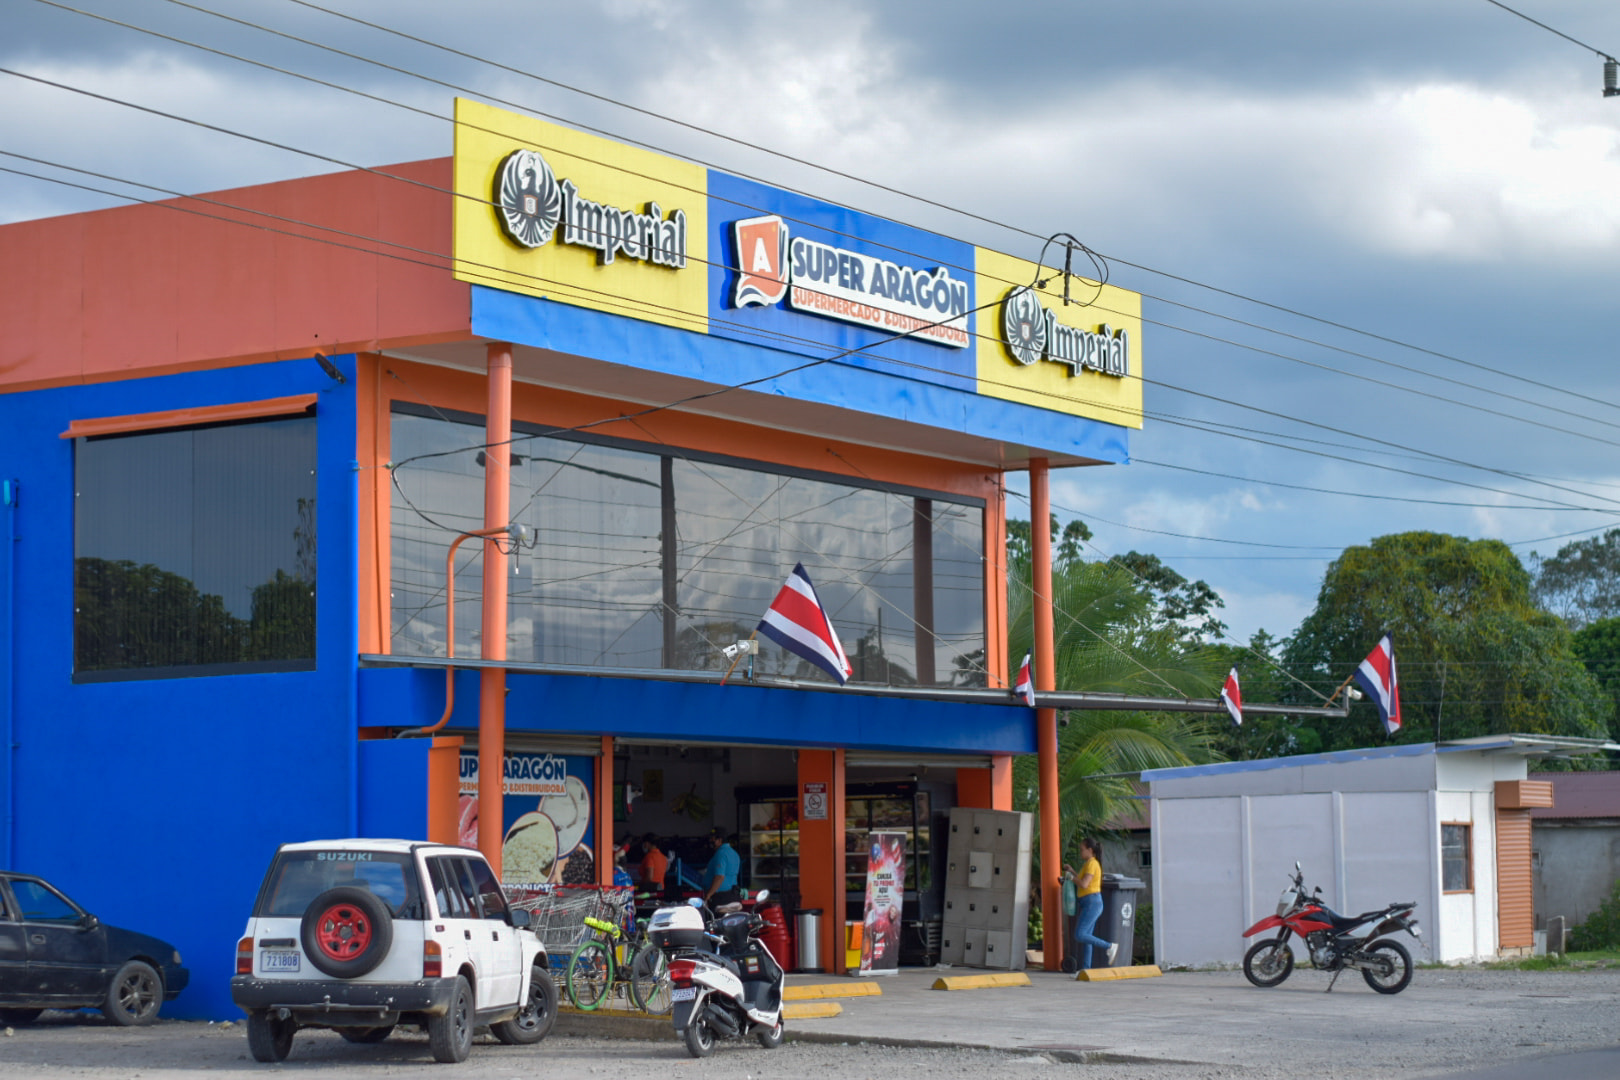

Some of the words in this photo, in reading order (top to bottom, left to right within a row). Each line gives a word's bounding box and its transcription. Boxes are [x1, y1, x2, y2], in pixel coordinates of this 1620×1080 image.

[562, 179, 687, 268] Imperial
[752, 237, 772, 273] A
[793, 241, 865, 293] SUPER
[869, 262, 966, 318] ARAGÓN
[793, 287, 881, 323] SUPERMERCADO
[1046, 309, 1129, 378] Imperial
[317, 852, 372, 861] SUZUKI
[267, 955, 298, 966] 721808
